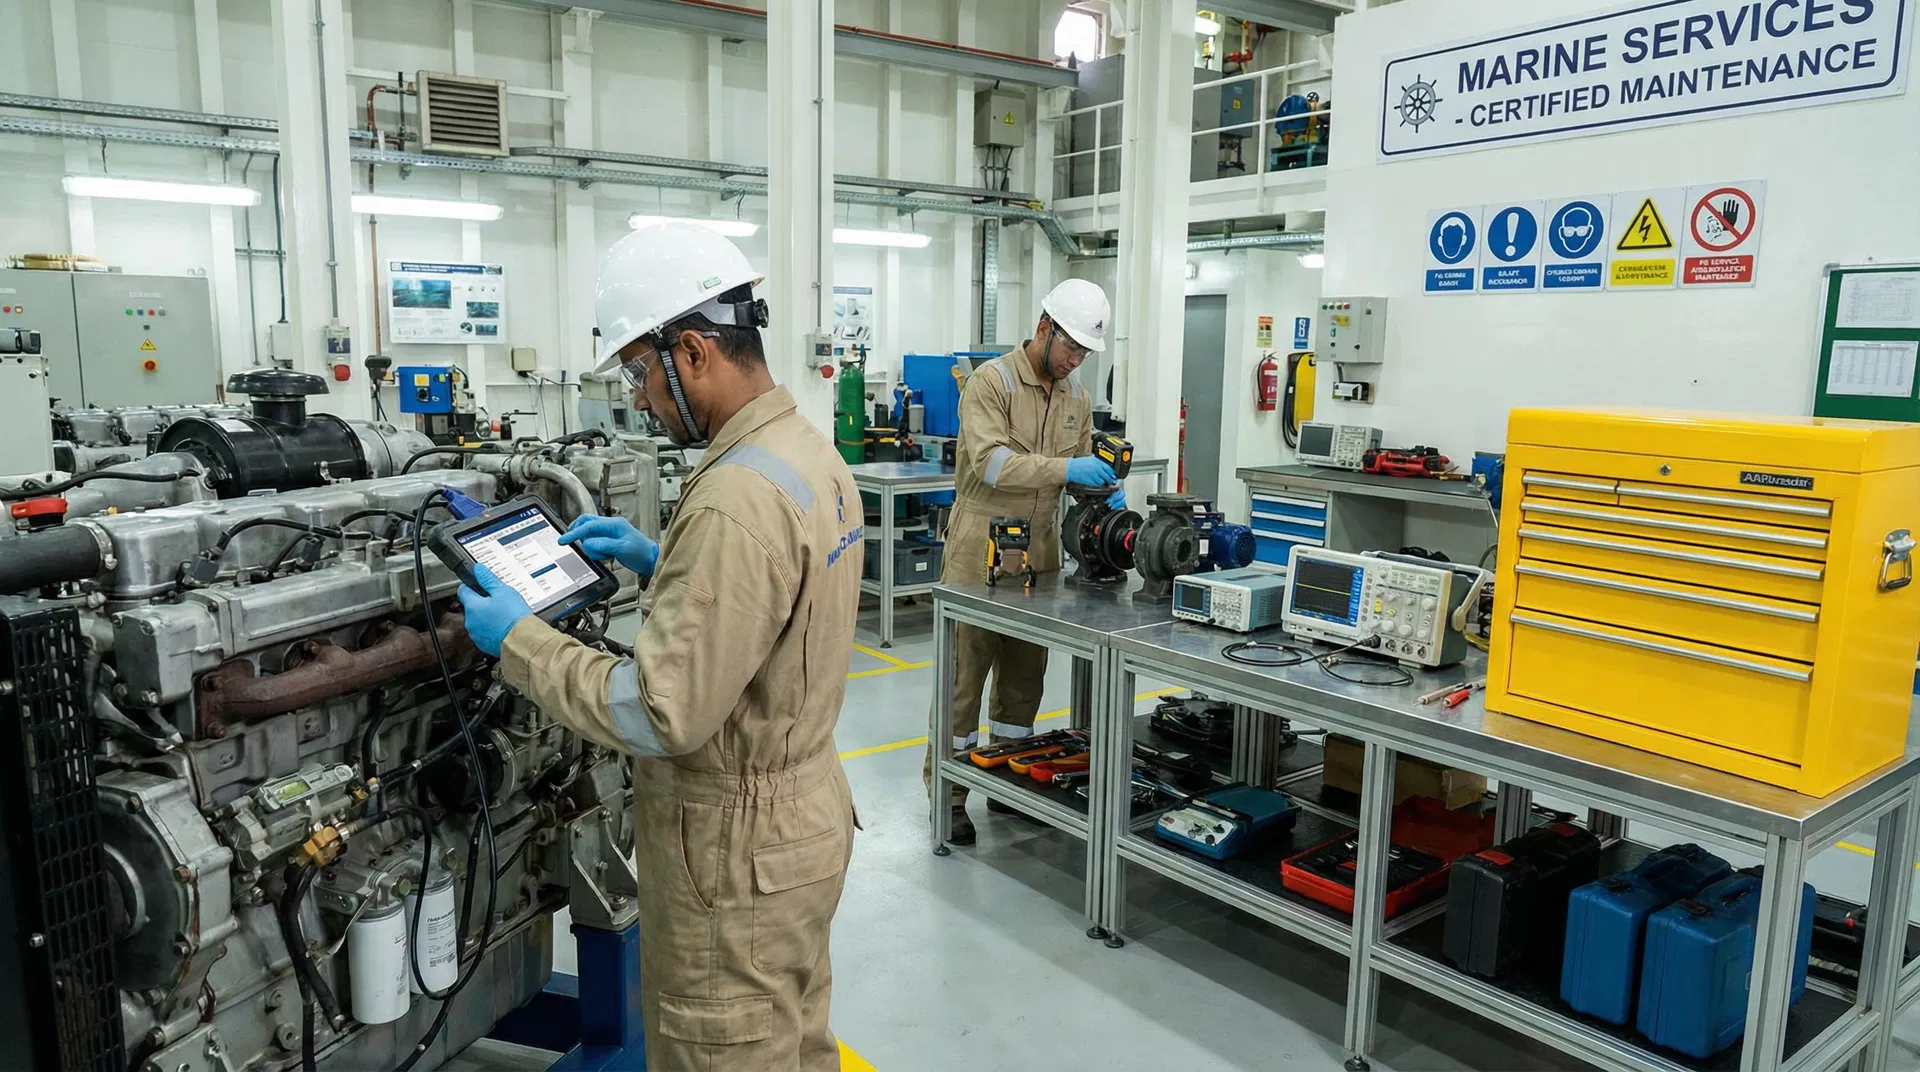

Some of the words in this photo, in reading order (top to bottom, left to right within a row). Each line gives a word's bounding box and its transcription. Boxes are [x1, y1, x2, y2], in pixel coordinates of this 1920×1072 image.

[1457, 33, 1608, 94] MARINE
[1621, 0, 1875, 64] SERVICES
[1470, 84, 1610, 127] CERTIFIED
[1620, 38, 1877, 105] MAINTENANCE
